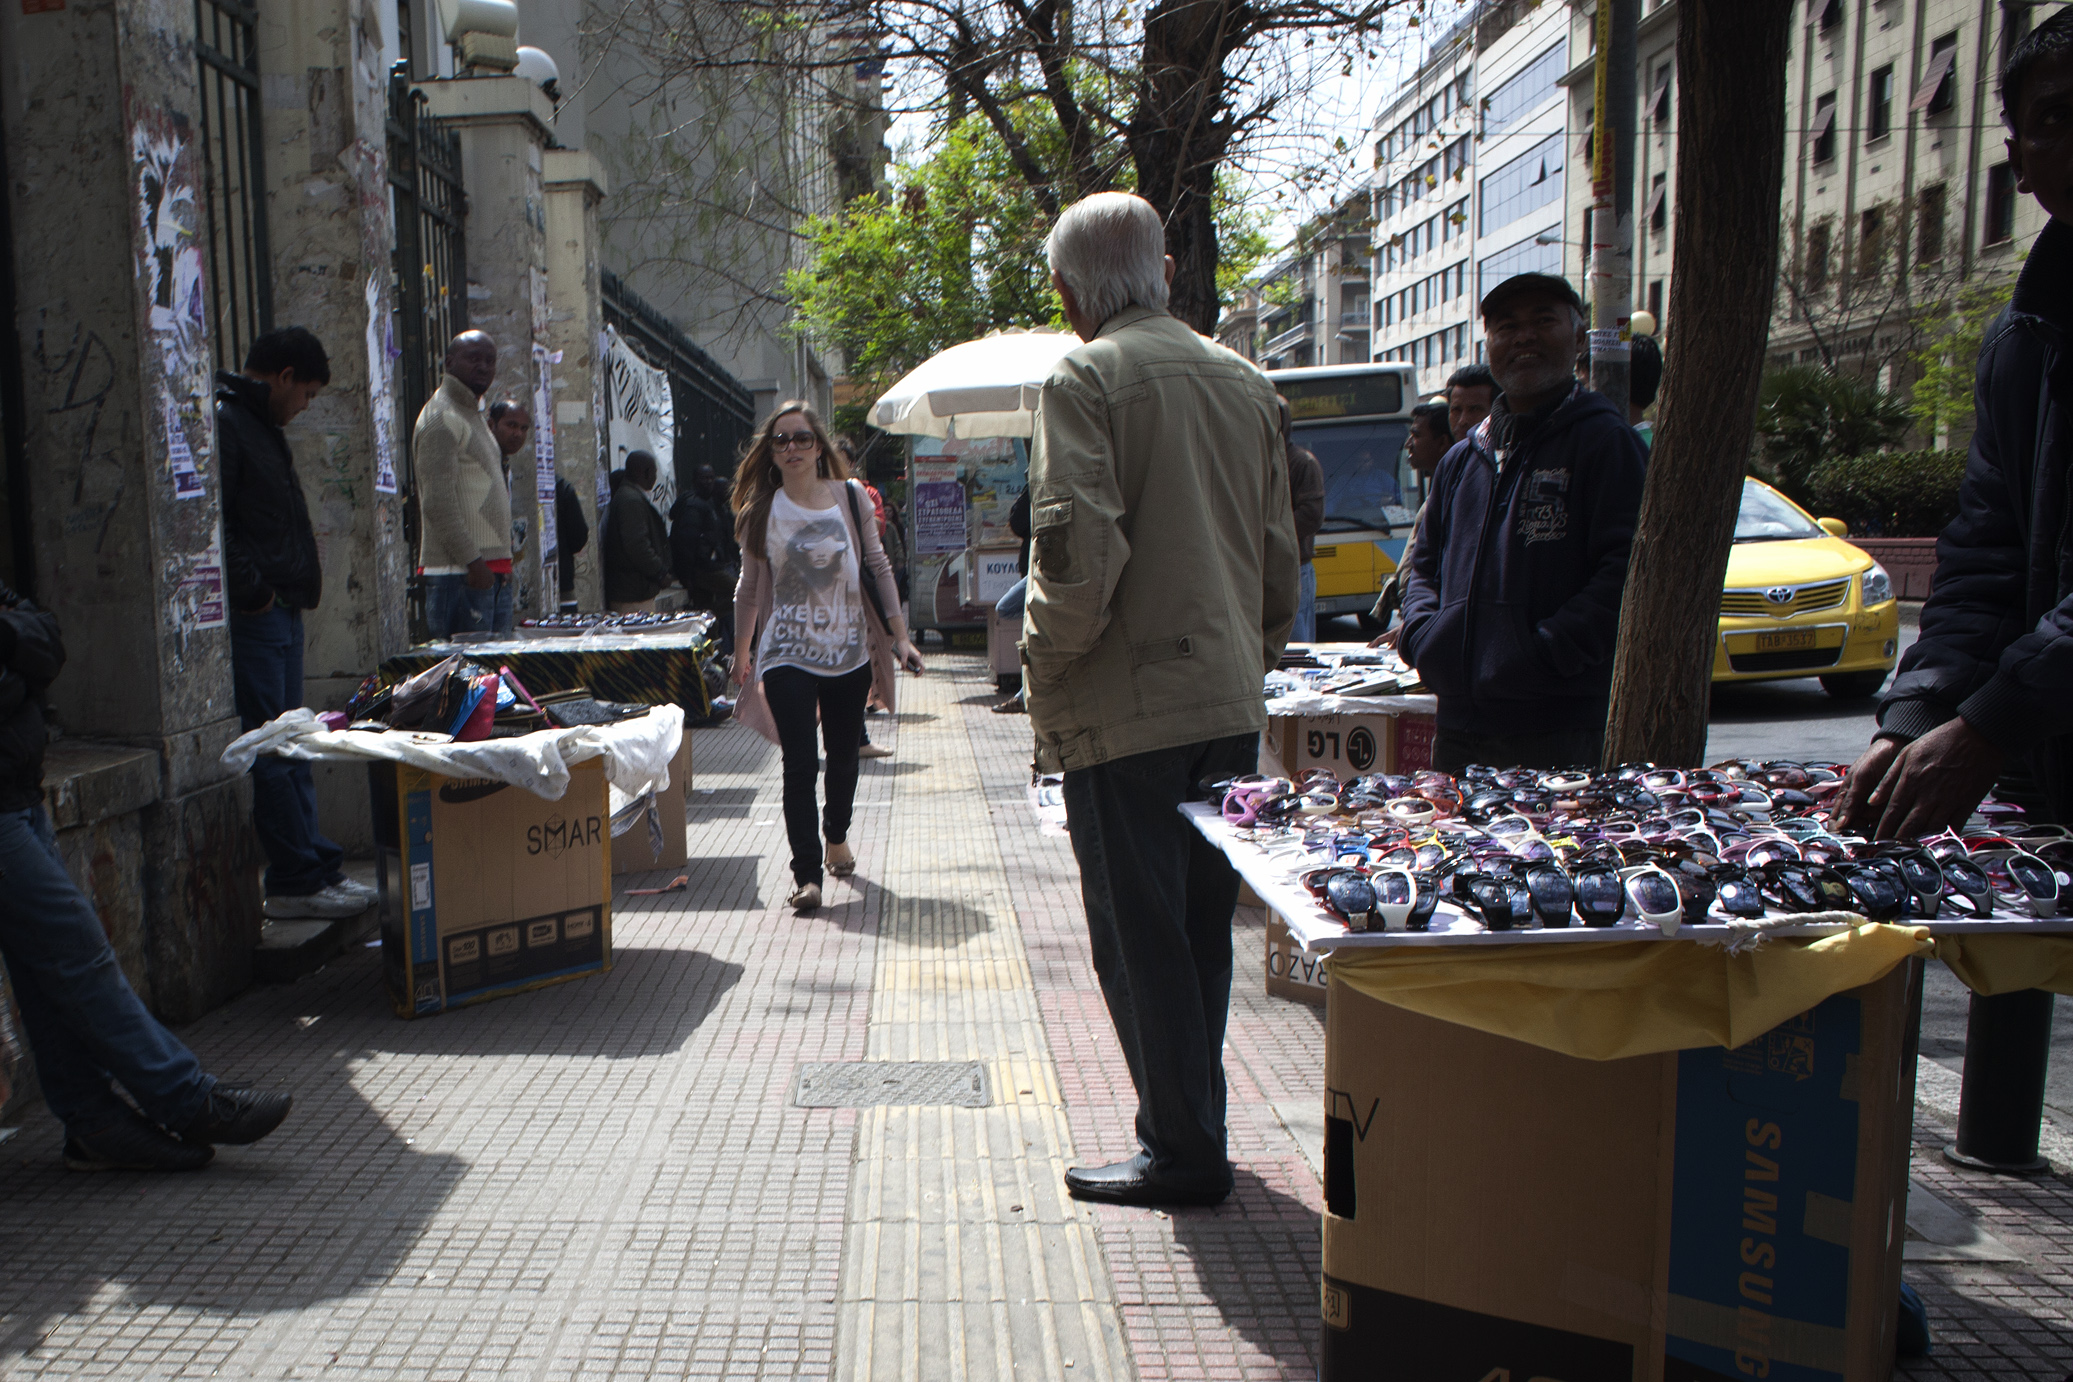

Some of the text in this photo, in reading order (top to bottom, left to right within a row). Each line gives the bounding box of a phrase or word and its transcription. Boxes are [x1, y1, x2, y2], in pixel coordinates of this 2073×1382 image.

[778, 643, 849, 666] TODAY
[1307, 730, 1341, 759] LG
[1327, 1087, 1381, 1142] TV
[1734, 1118, 1782, 1377] SAMSUNG
